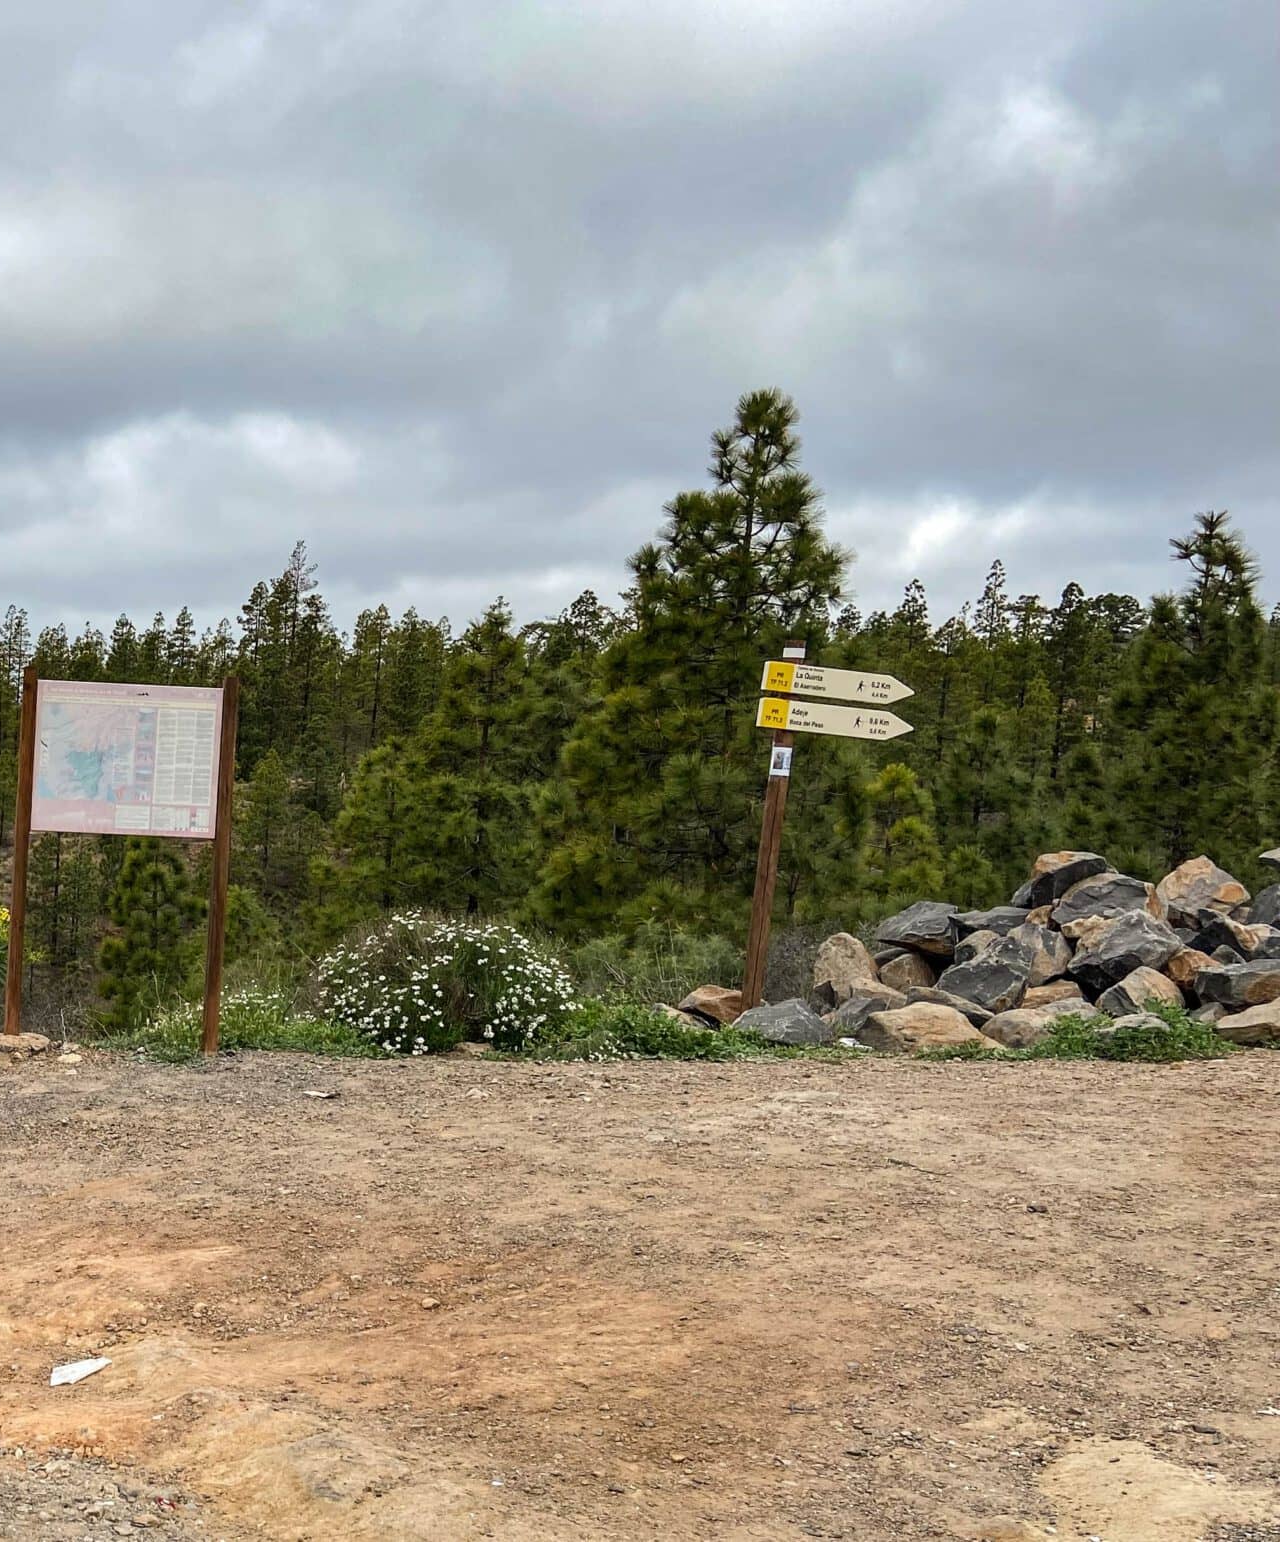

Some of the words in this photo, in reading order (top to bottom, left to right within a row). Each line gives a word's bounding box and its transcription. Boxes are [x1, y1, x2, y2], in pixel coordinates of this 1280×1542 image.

[795, 671, 803, 679] La
[804, 672, 823, 682] Quinta
[881, 682, 891, 690] Km
[791, 708, 809, 718] Adeje
[880, 719, 890, 727] Km
